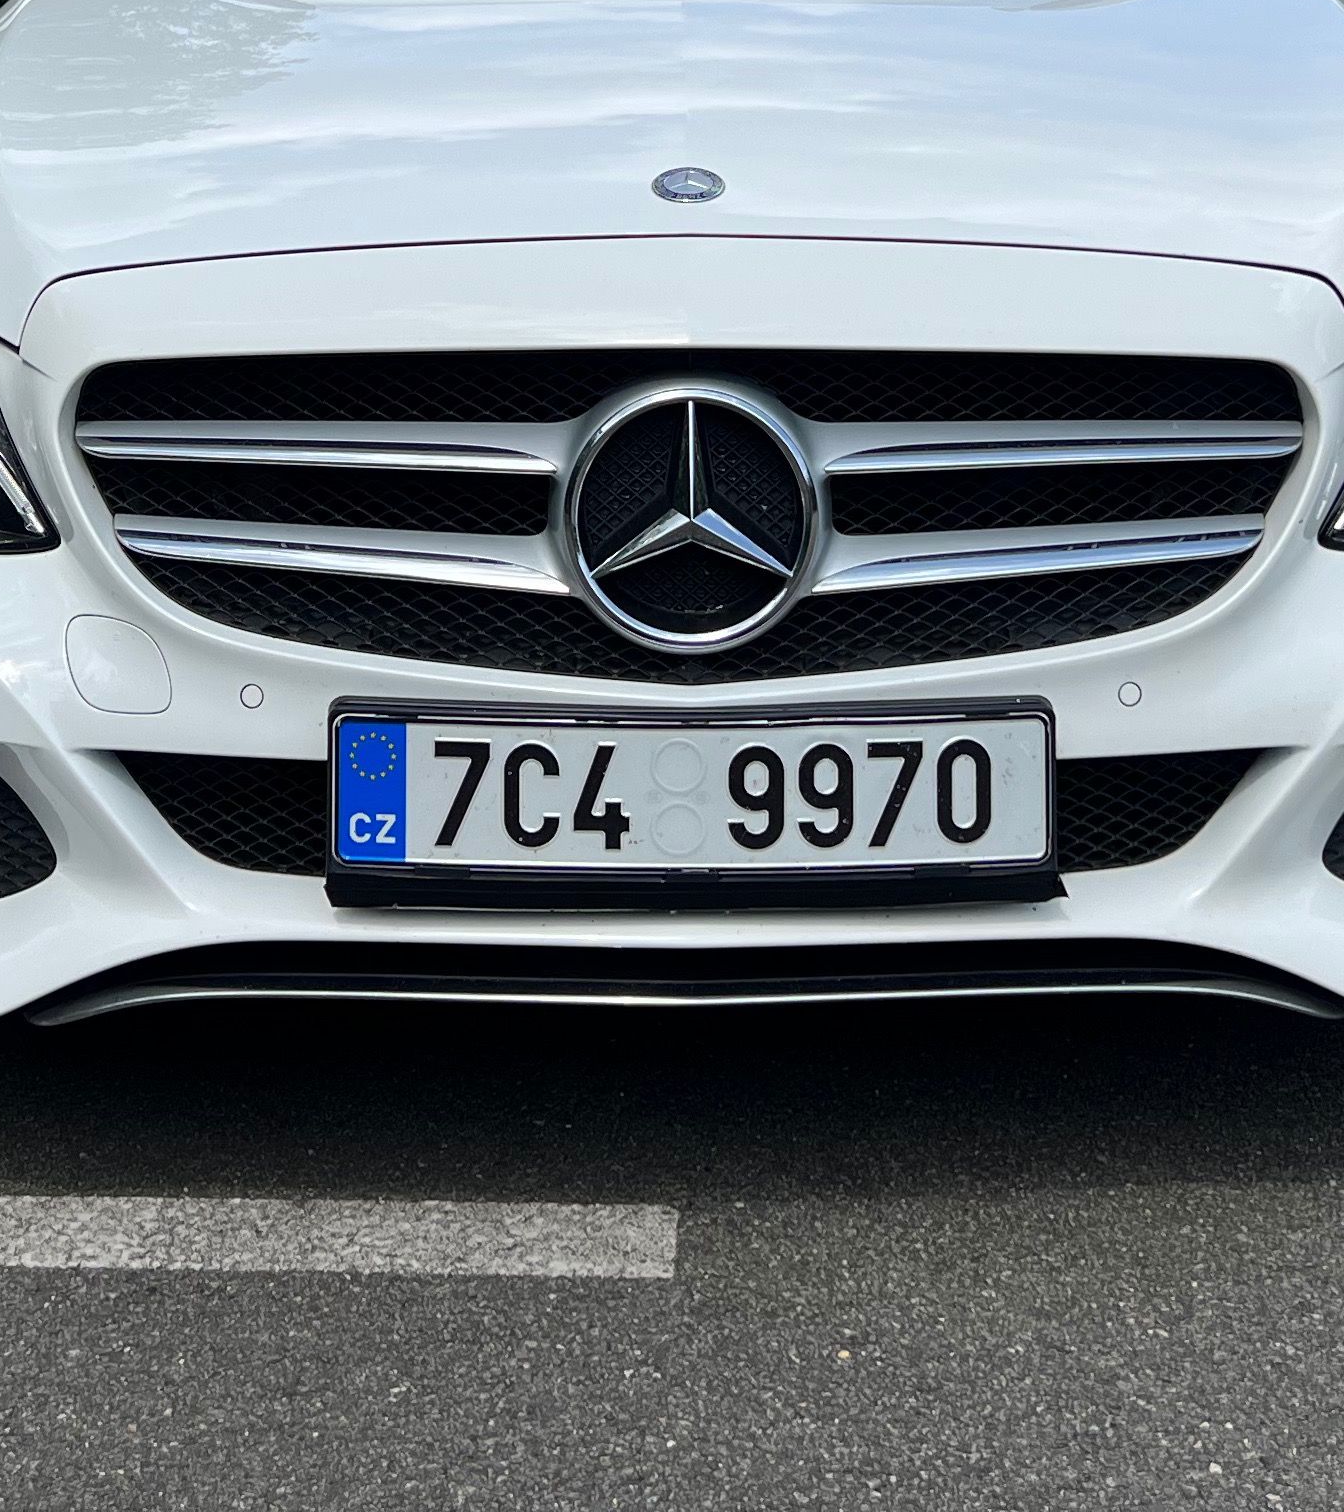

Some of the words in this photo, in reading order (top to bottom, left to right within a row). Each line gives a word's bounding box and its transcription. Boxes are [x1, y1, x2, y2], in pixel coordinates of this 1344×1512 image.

[348, 812, 397, 844] CZ
[433, 740, 631, 851] 7C4
[726, 737, 992, 851] 9970
